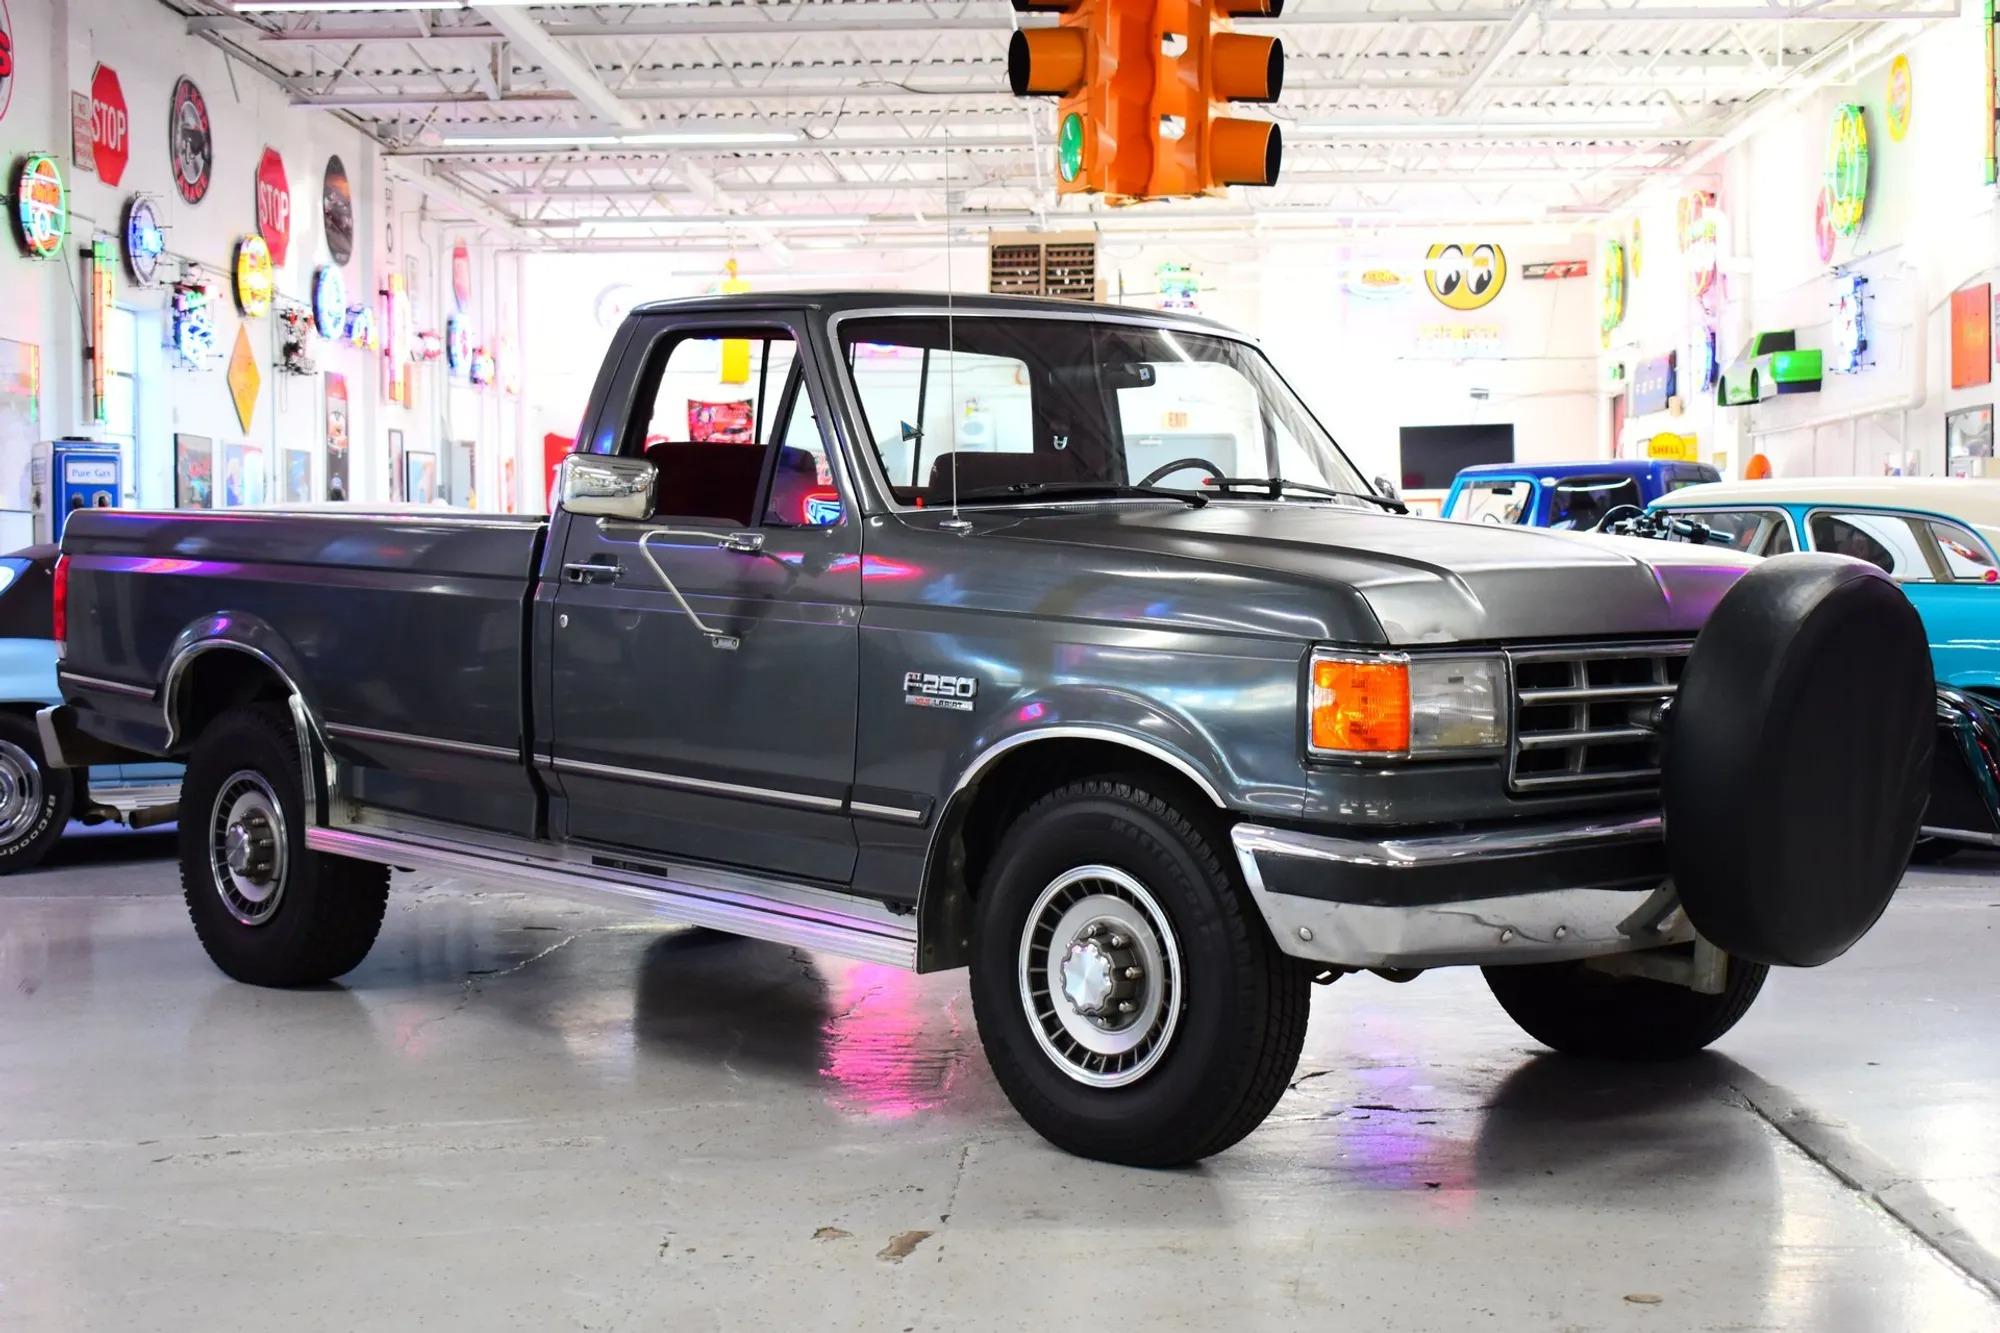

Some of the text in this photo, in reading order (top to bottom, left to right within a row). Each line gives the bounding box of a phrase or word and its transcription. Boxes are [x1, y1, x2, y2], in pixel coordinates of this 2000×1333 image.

[92, 98, 126, 152] STOP
[259, 181, 289, 232] STOP
[1651, 444, 1681, 456] SHELL
